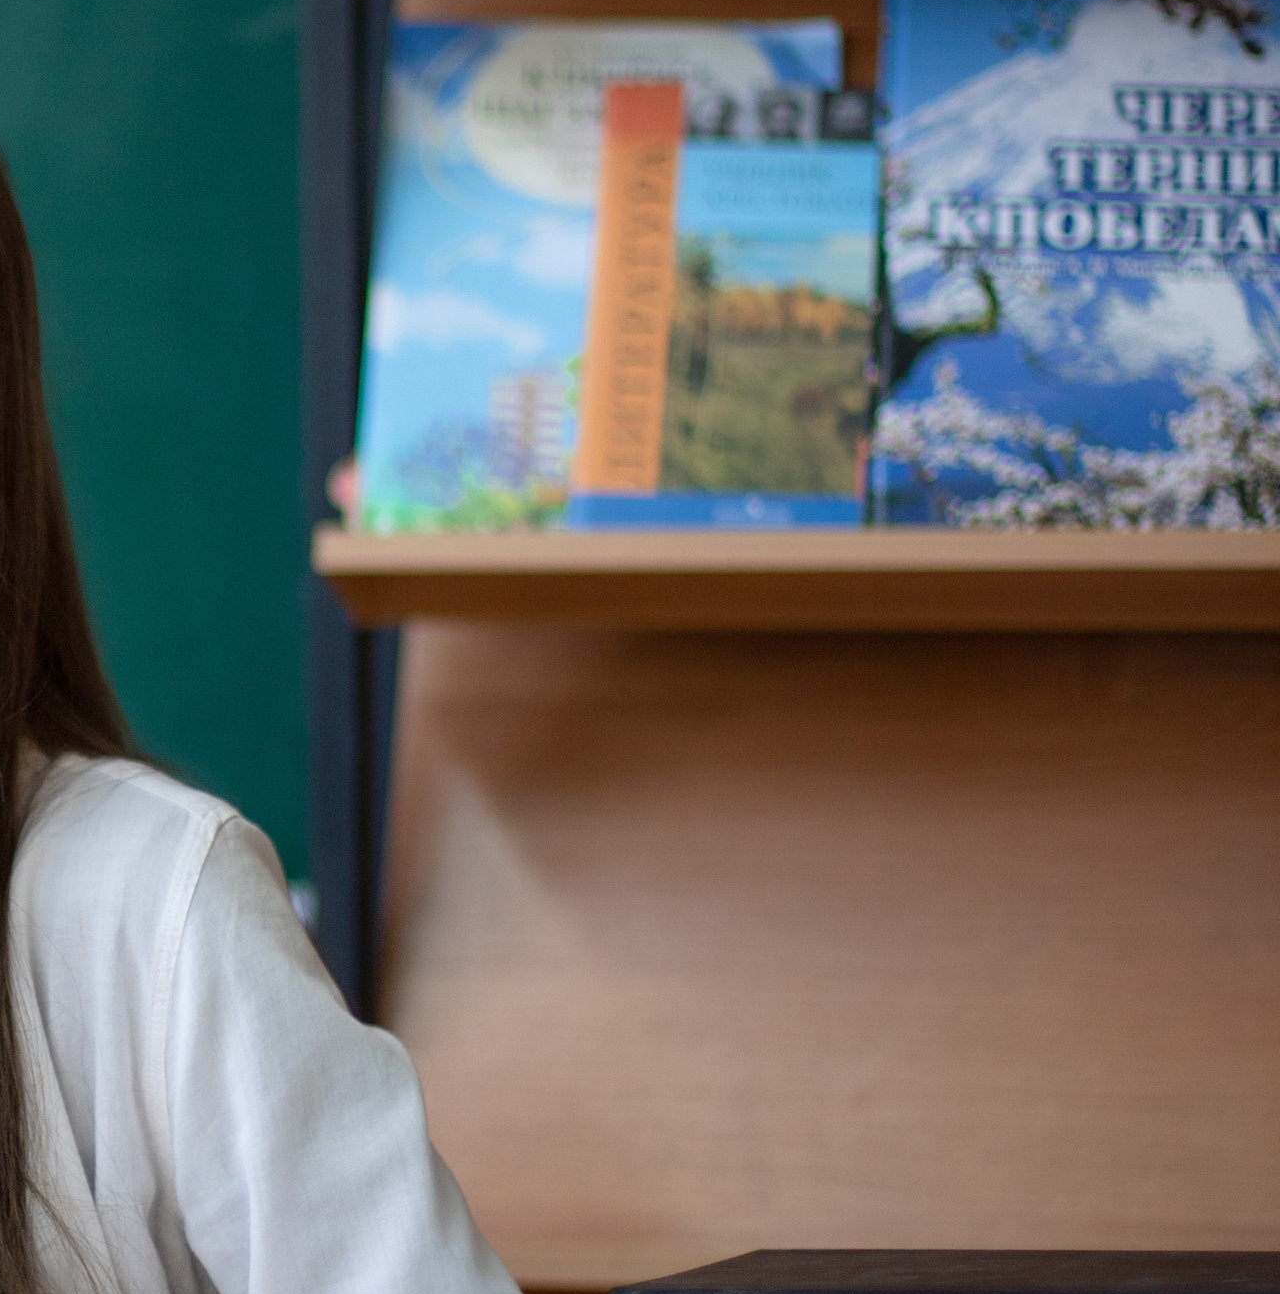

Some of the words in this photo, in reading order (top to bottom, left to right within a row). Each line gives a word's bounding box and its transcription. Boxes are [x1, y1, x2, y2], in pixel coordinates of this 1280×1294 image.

[1114, 86, 1280, 136] ЧЕРЕ
[930, 198, 982, 248] К
[994, 199, 1280, 251] ПОБЕДА
